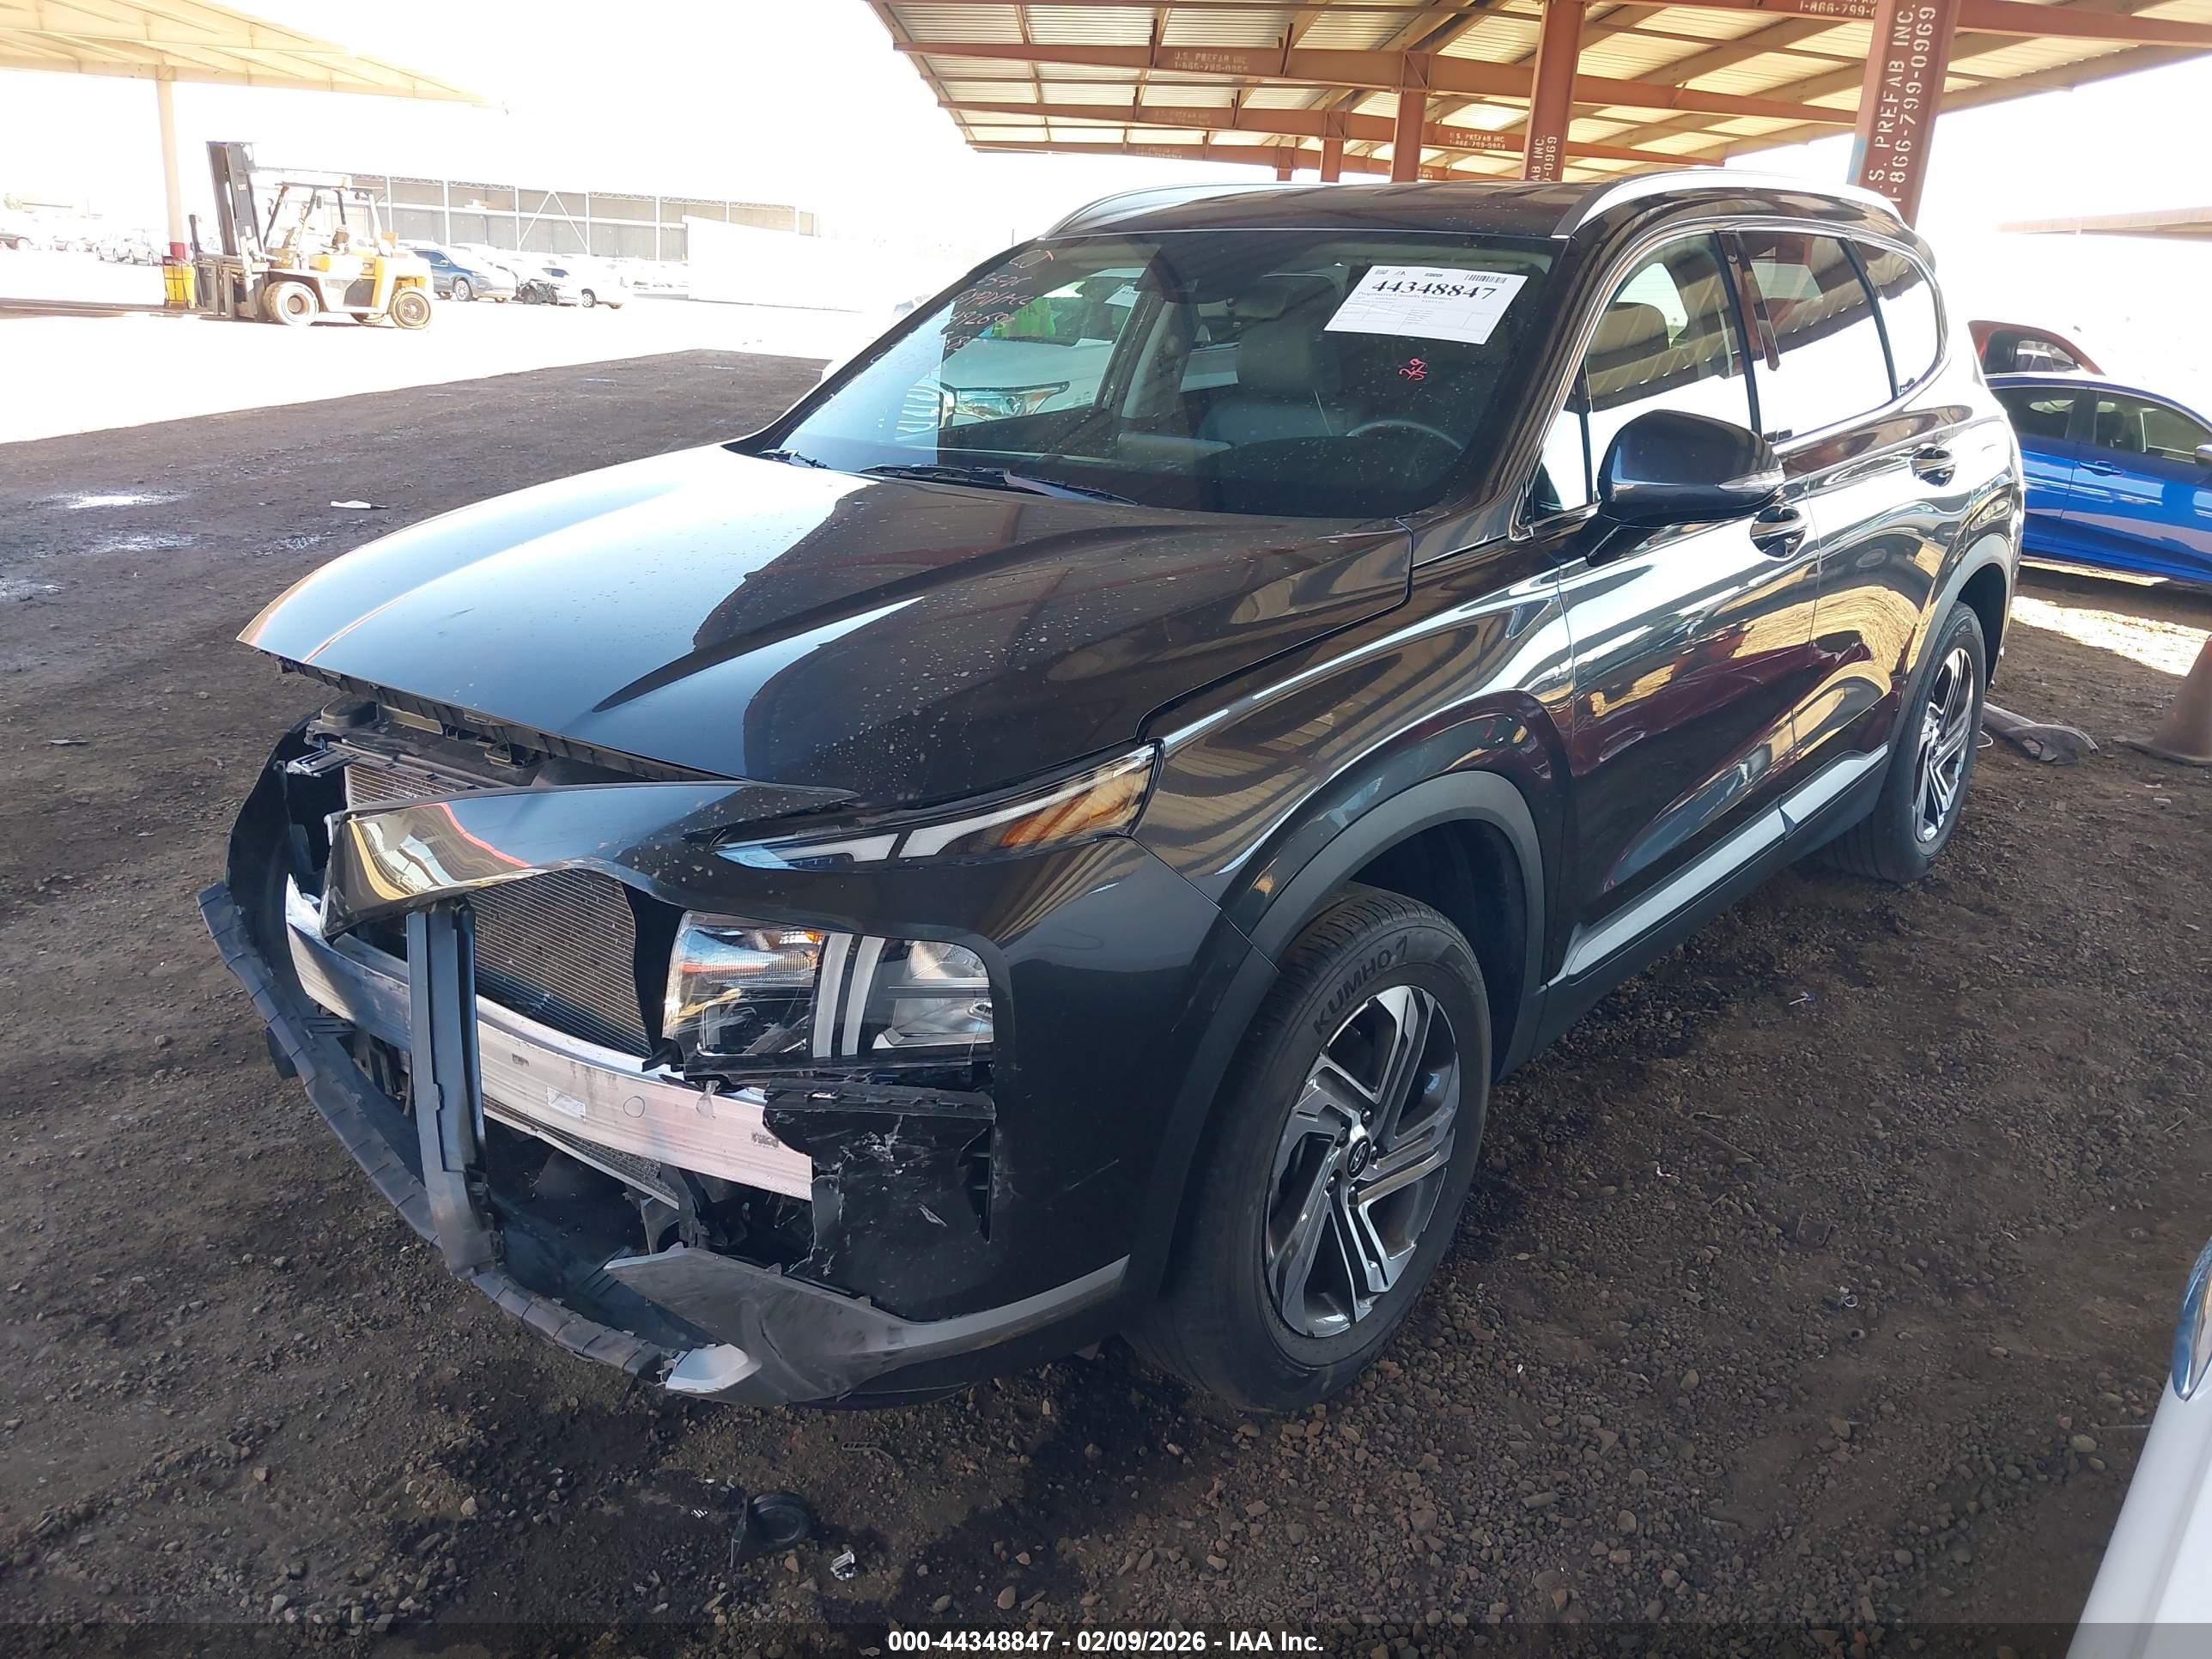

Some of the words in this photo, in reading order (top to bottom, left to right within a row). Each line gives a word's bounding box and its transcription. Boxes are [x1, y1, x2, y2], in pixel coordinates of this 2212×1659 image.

[1875, 59, 1905, 148] PREFAB
[1892, 3, 1916, 46] INC.
[1889, 6, 1936, 203] 1-866-799-0969
[1372, 280, 1498, 300] 44348847
[1313, 950, 1393, 1034] KUMHO
